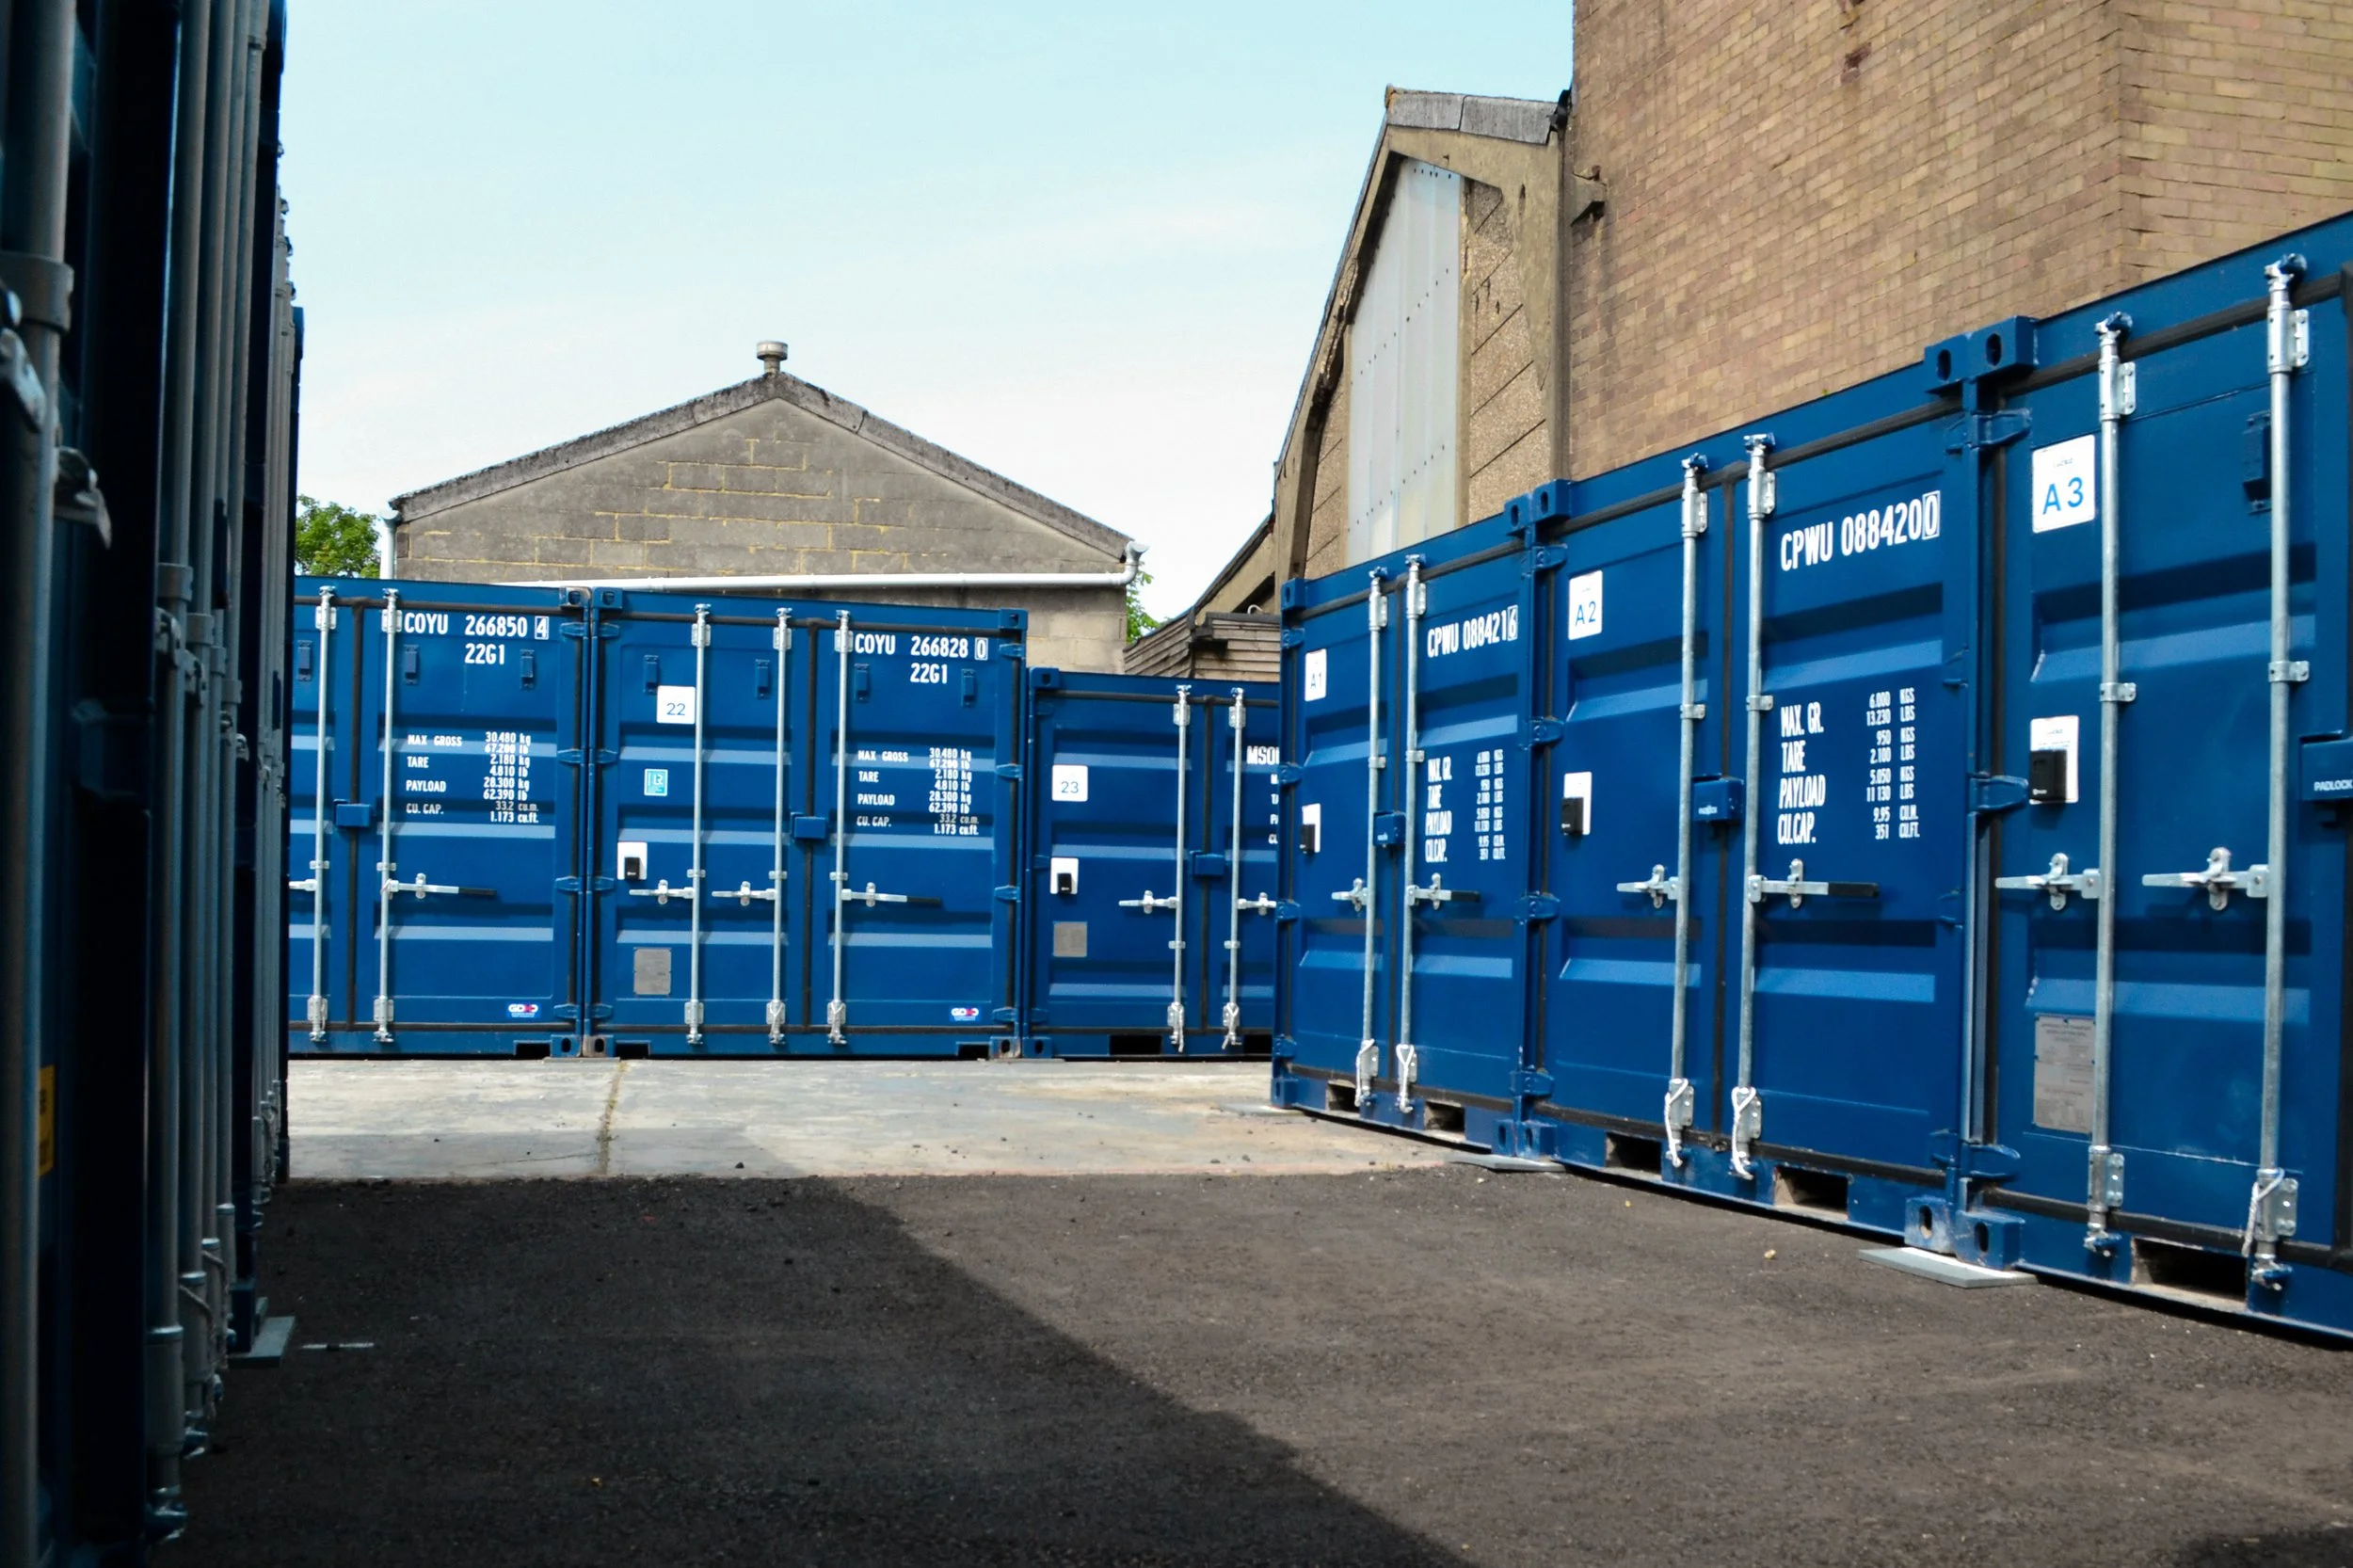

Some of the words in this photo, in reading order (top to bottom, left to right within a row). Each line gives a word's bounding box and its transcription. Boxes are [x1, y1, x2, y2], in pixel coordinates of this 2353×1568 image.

[1781, 521, 1833, 571] CPWU
[404, 613, 449, 635] COYU
[464, 615, 528, 637] 266850
[534, 616, 549, 640] 4
[855, 633, 896, 655] COYU
[910, 635, 968, 659] 266828
[974, 637, 988, 661] 0
[1427, 622, 1459, 658] CPWU
[464, 643, 505, 664] 22G1
[910, 662, 948, 684] 22G1
[666, 702, 686, 716] 22
[1781, 705, 1805, 738] MAX.
[1807, 701, 1824, 734] GR.
[407, 734, 427, 745] MAX
[434, 735, 462, 747] GROSS
[485, 731, 517, 743] 30.480
[520, 733, 532, 746] kg
[407, 756, 429, 768] TARE
[519, 755, 530, 768] kg
[857, 750, 876, 760] MAX
[960, 749, 971, 762] kg
[1781, 740, 1806, 773] TARE
[518, 766, 528, 777] lb
[858, 771, 879, 783] TARE
[961, 771, 972, 782] kg
[406, 779, 447, 792] PAYLOAD
[517, 777, 530, 791] kg
[1061, 781, 1080, 793] 23
[1779, 775, 1827, 808] PAYLOAD
[483, 789, 515, 800] 62.390
[517, 790, 527, 801] lb
[857, 793, 895, 806] PAYLOAD
[960, 792, 972, 805] kg
[406, 803, 421, 814] CU.
[423, 803, 444, 815] CAP.
[489, 810, 514, 824] 1.173
